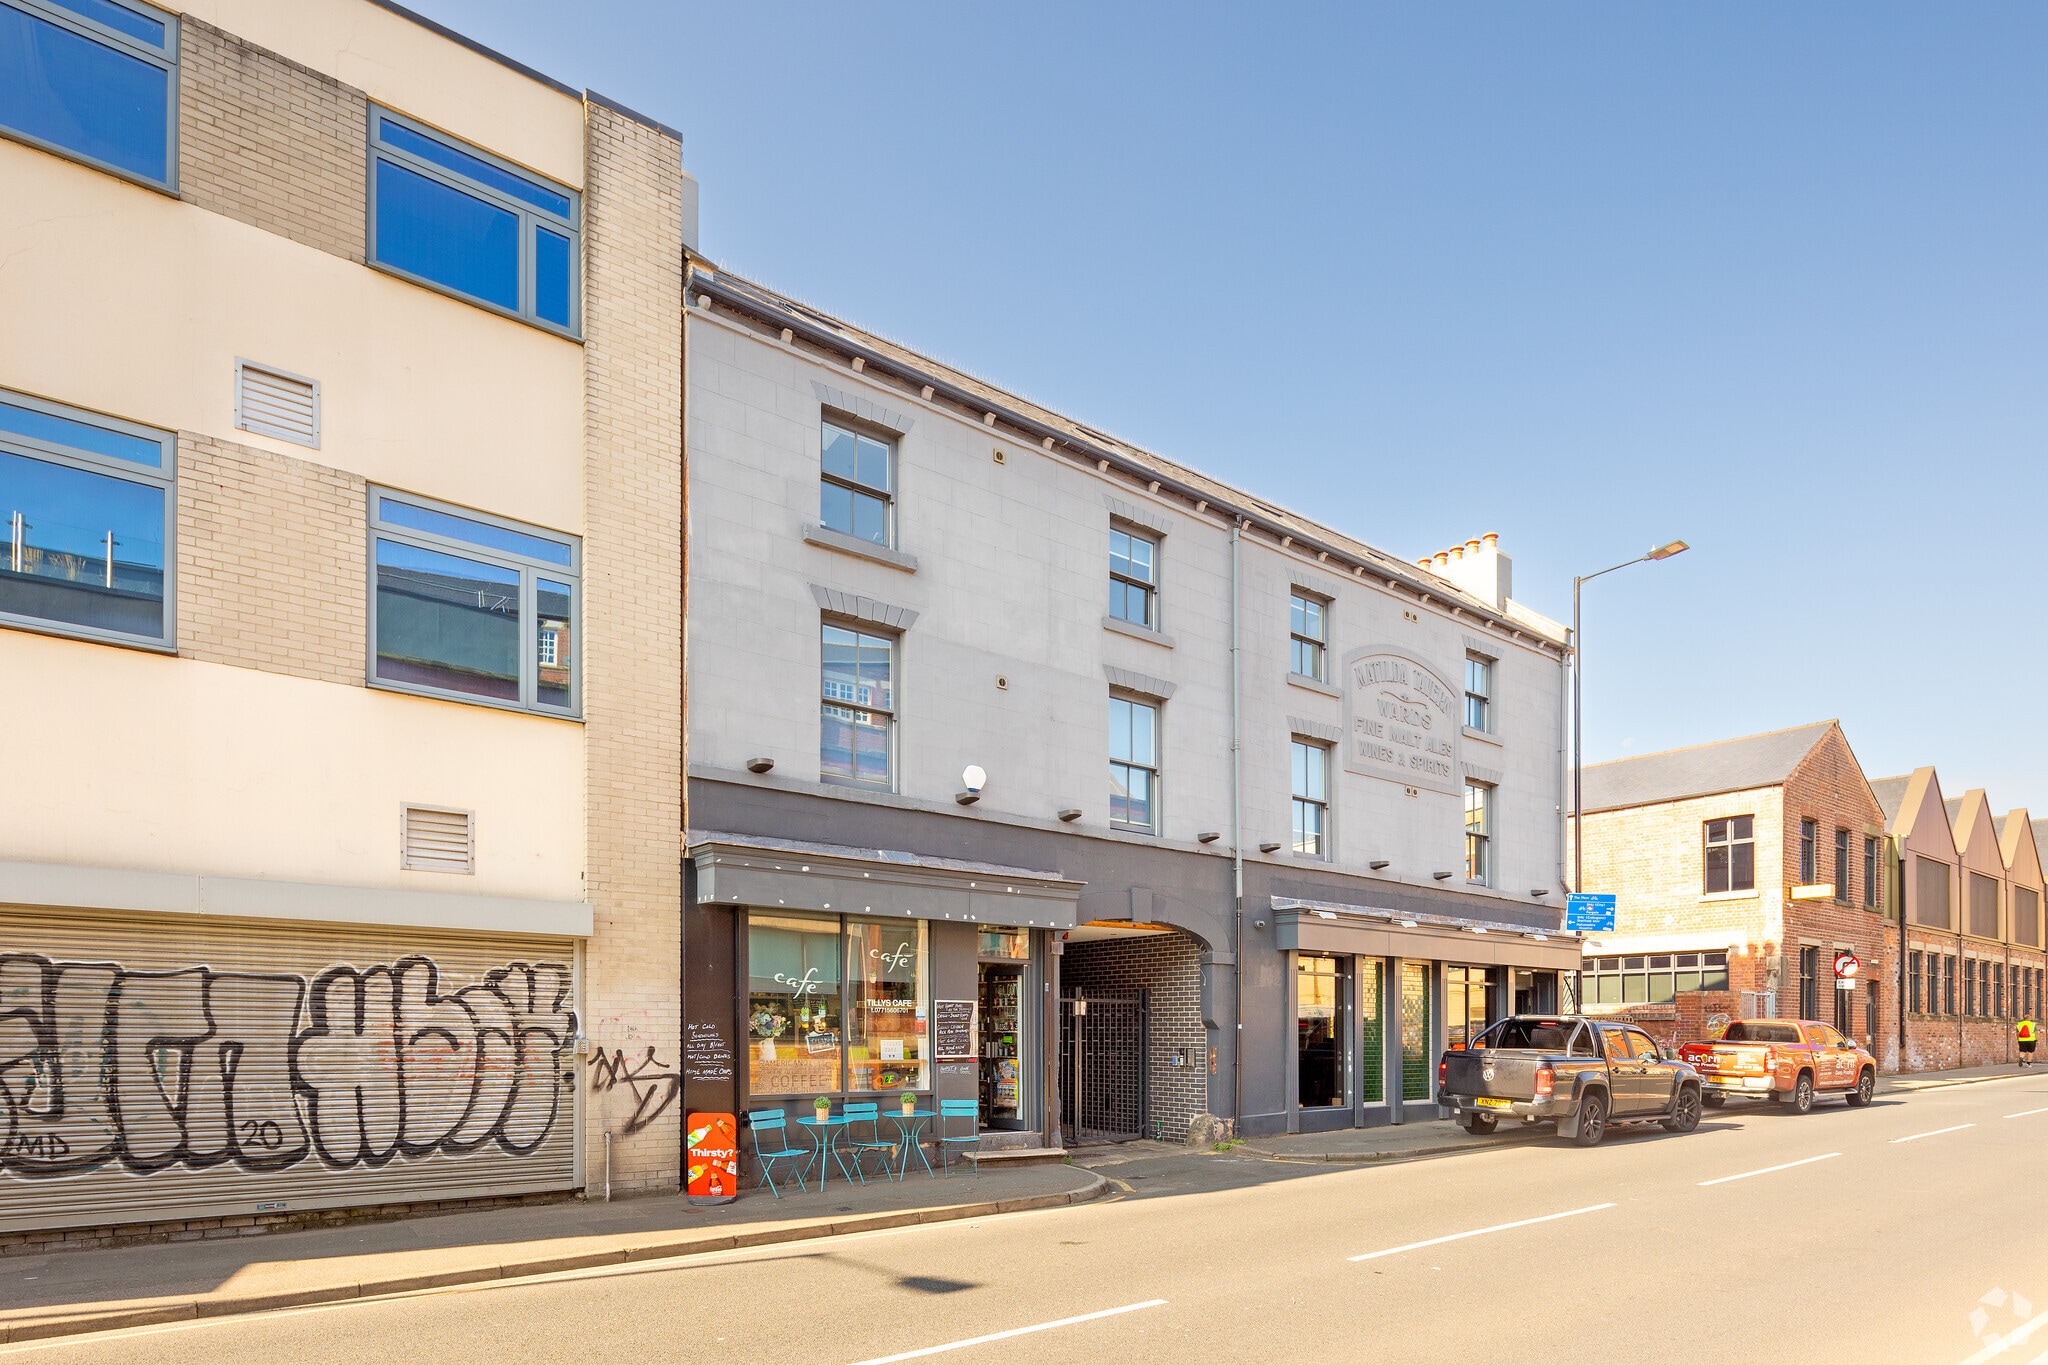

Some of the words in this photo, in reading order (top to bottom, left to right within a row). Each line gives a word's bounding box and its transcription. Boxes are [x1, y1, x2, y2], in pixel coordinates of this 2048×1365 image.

[1354, 661, 1409, 689] MATILDA
[1412, 669, 1453, 717] TAVERN
[1377, 699, 1432, 730] WARDS
[1354, 716, 1384, 739] FINE
[1389, 724, 1422, 749] MALT
[1425, 736, 1453, 757] ALES
[1358, 739, 1394, 763] WINES
[1398, 753, 1406, 767] &
[1409, 755, 1450, 777] SPIRITS
[867, 999, 891, 1007] TILLYS
[892, 999, 912, 1007] CAFE
[771, 1074, 827, 1088] COFFEE
[240, 1119, 284, 1150] 20
[690, 1148, 734, 1159] Thirsty?
